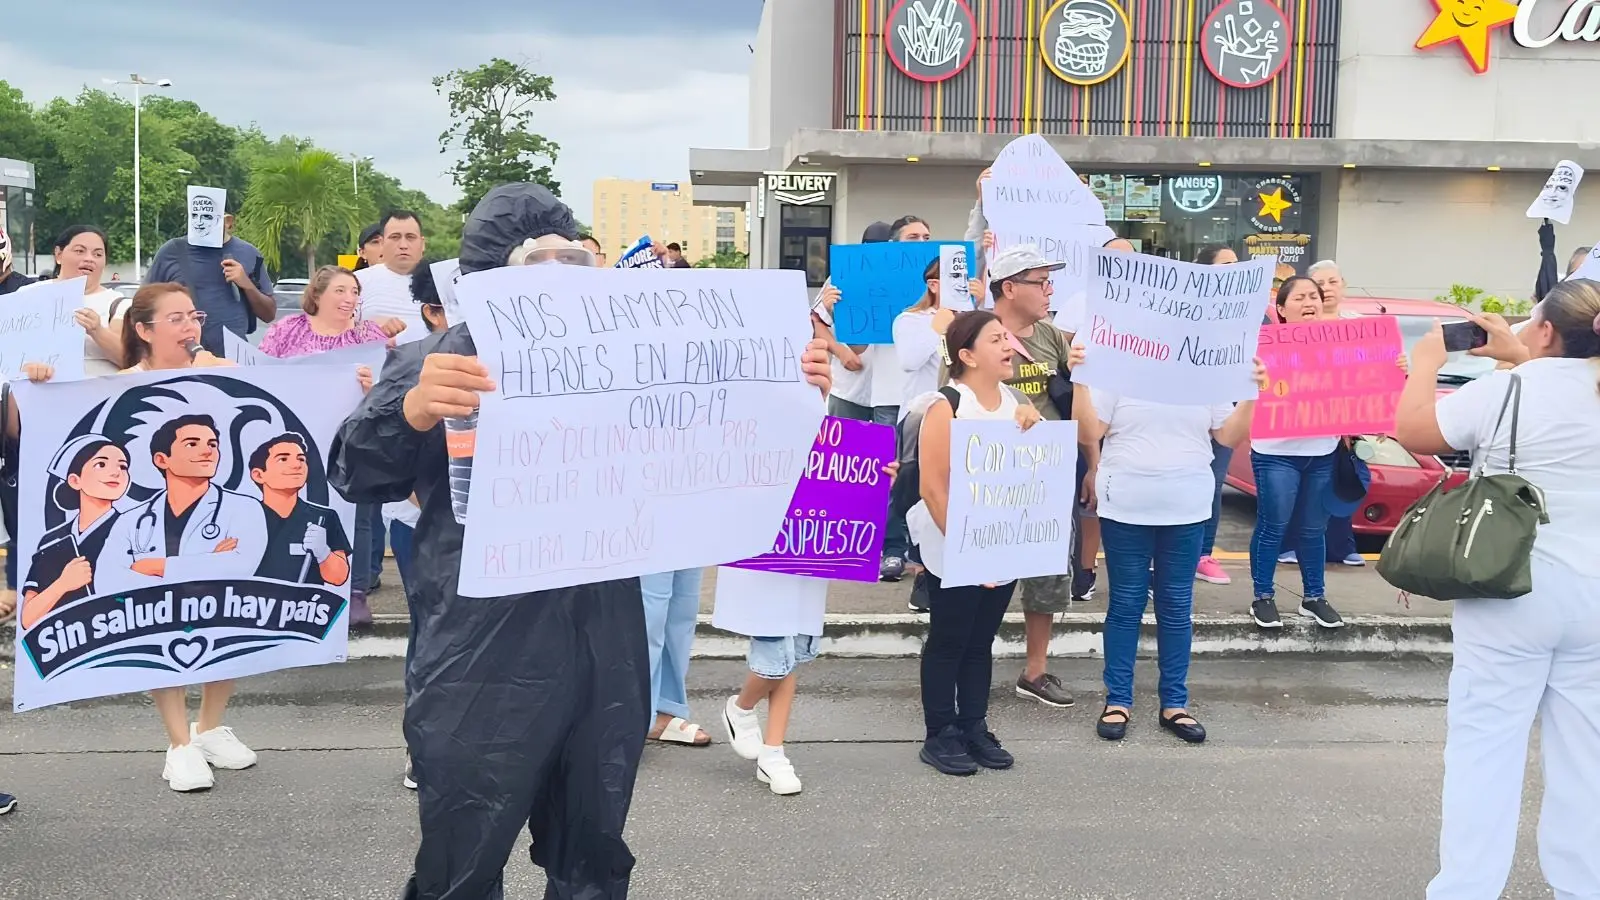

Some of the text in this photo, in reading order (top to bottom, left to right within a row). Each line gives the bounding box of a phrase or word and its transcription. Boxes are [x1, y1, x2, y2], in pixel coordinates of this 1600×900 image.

[768, 175, 832, 191] DELIVERY
[1175, 176, 1216, 189] ANGUS
[1279, 246, 1305, 255] TODOS
[1183, 266, 1264, 298] MEXICANO
[487, 288, 745, 341] NOS LLAMARON
[1140, 290, 1203, 322] SEGURO
[1090, 314, 1170, 362] Patrimonio
[1259, 322, 1388, 345] SEGURIDAD
[501, 336, 800, 396] HÉROES EN PANDEMIA
[629, 388, 727, 430] COVID-19
[498, 430, 549, 467] HOY
[722, 418, 758, 449] POR
[965, 433, 1006, 475] Con
[492, 448, 795, 508] EXIGIR UN SALARIO JUSTO
[633, 498, 646, 526] Y
[582, 517, 655, 562] DIGNO
[37, 586, 331, 663] Sin salud no hay país
